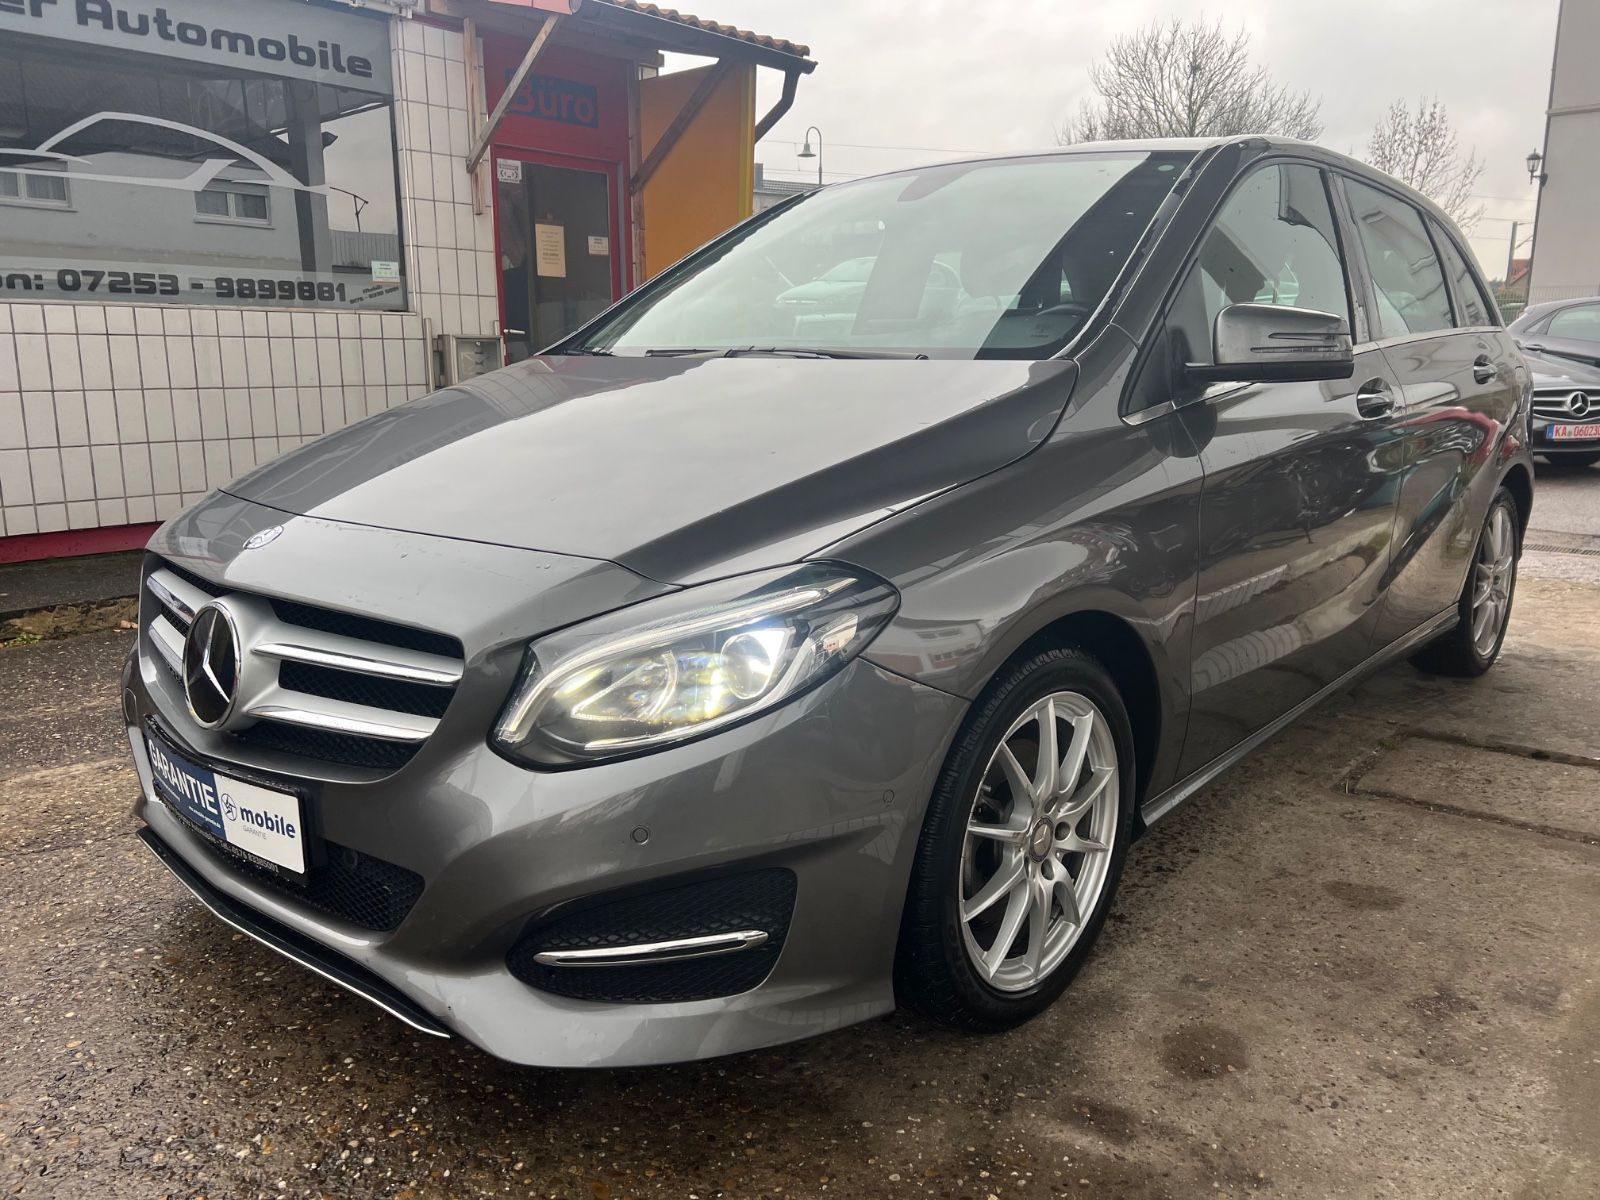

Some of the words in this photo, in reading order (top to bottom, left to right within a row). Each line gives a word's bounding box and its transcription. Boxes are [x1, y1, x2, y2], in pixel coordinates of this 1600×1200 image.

[75, 0, 373, 78] Automobile
[509, 77, 595, 123] Büro
[0, 273, 43, 290] n:
[57, 269, 179, 295] 07253
[215, 277, 346, 302] 9899881
[1554, 426, 1567, 437] KA
[148, 739, 219, 815] GARANTIE
[240, 806, 296, 839] mobile
